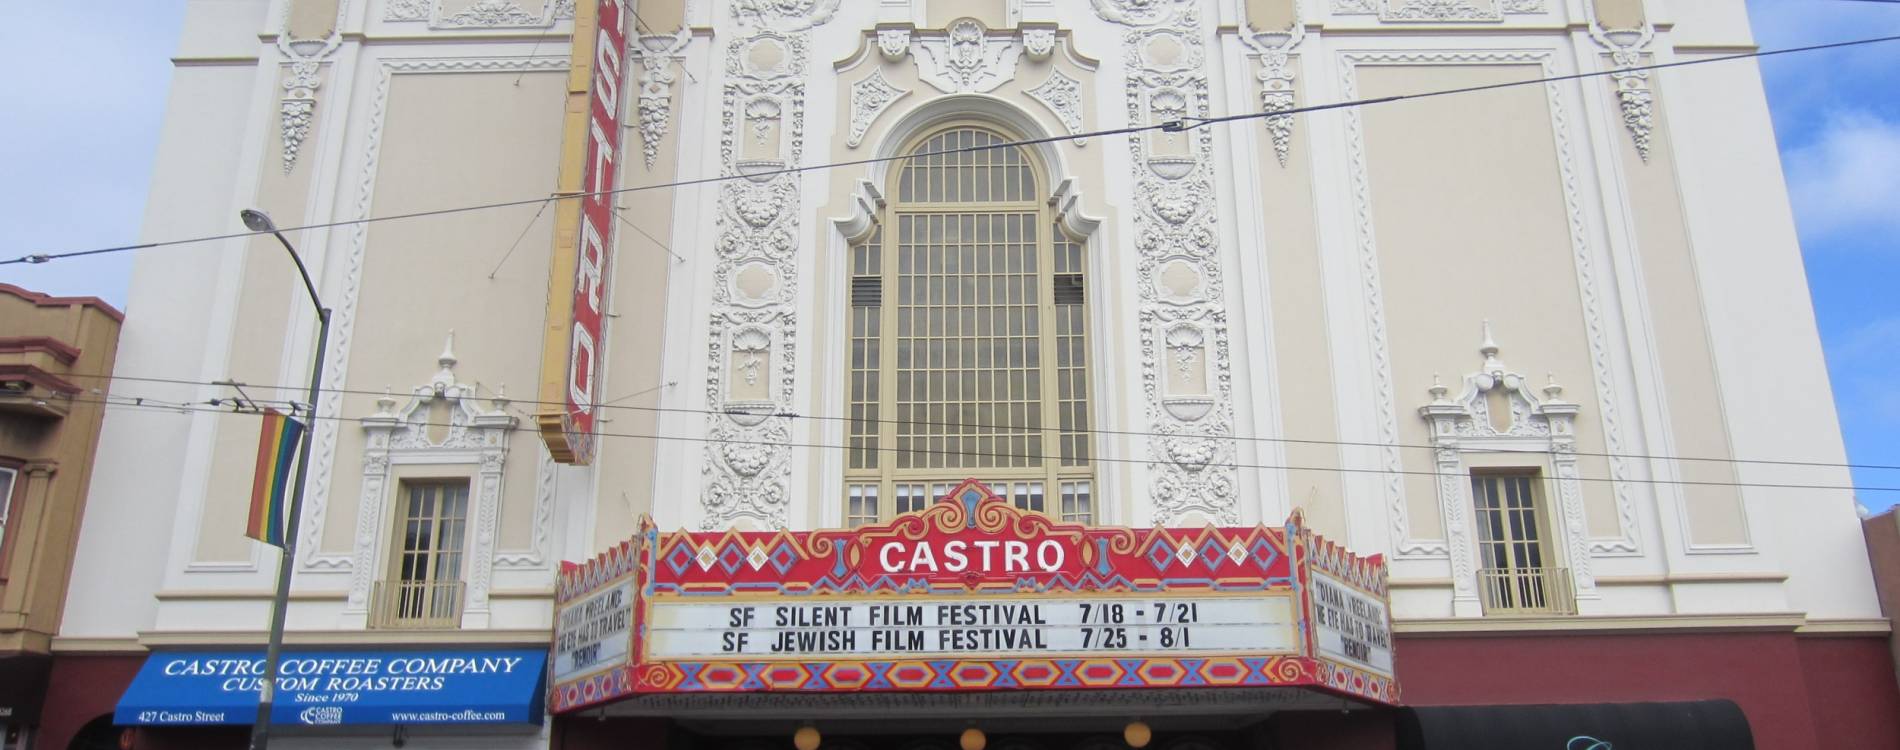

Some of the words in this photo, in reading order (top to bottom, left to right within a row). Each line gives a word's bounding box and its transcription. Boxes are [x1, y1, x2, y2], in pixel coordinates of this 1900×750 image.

[879, 540, 1065, 573] CASTRO
[729, 607, 755, 627] SF
[776, 606, 851, 626] SILENT
[869, 605, 923, 626] FILM
[937, 604, 1046, 625] FESTIVAL
[1079, 603, 1124, 624] 7/18
[1154, 602, 1198, 623] 7/21
[722, 632, 748, 652] SF
[771, 630, 855, 651] JEWISH
[872, 630, 924, 650] FILM
[938, 628, 1047, 650] FESTIVAL
[1081, 627, 1127, 649] 7/25
[1160, 627, 1190, 648] 8/1
[165, 659, 267, 675] CASTRO
[280, 658, 382, 675] COFFEE
[387, 657, 522, 675] COMPANY
[326, 676, 445, 691] ROASTERS
[295, 693, 329, 702] Since
[332, 692, 359, 702] 1970
[138, 711, 157, 722] 427
[160, 710, 193, 722] Castro
[195, 710, 225, 722] Street
[392, 709, 505, 721] www.castro-coffee.com
